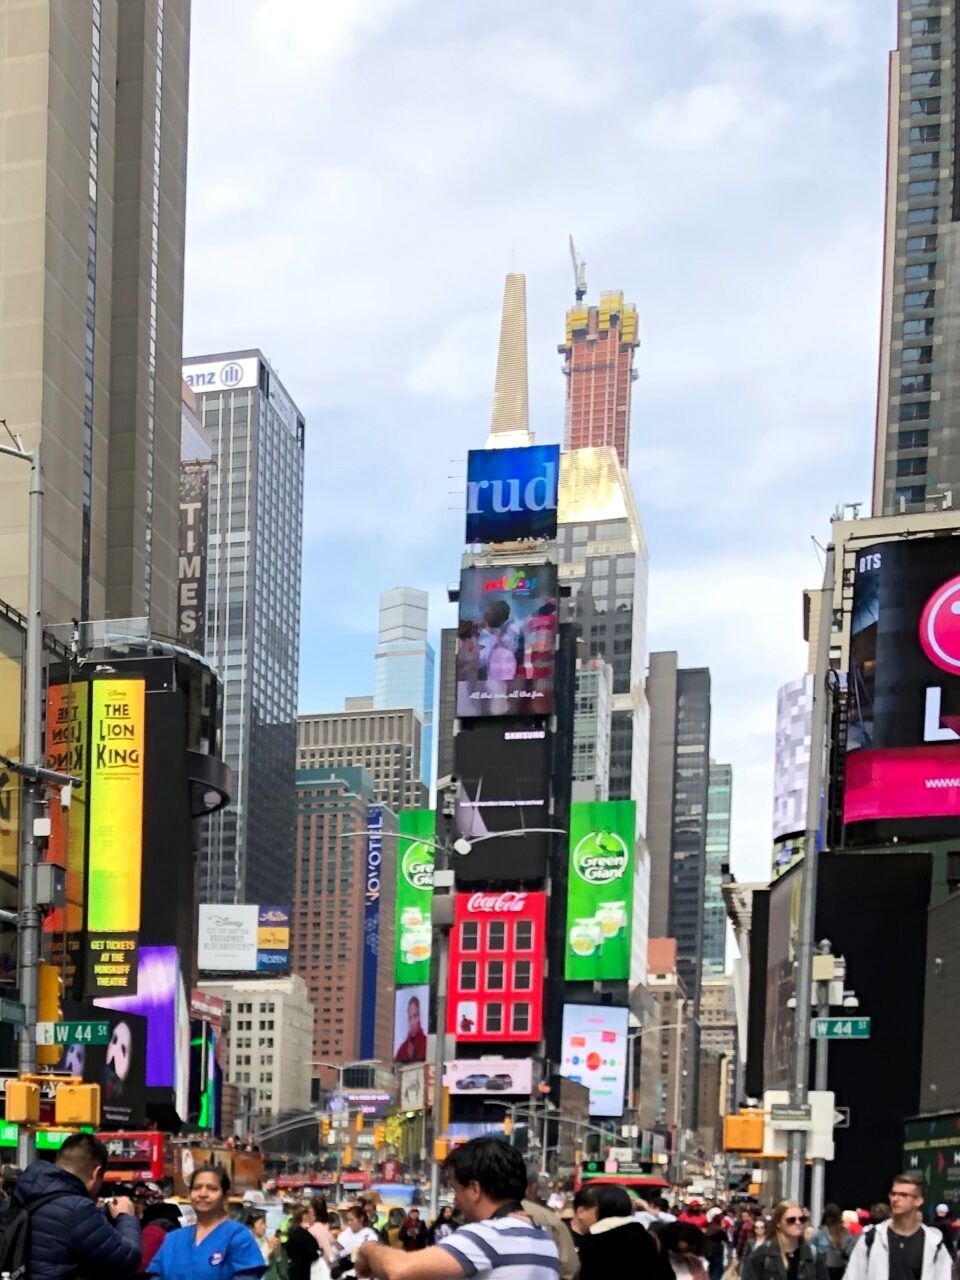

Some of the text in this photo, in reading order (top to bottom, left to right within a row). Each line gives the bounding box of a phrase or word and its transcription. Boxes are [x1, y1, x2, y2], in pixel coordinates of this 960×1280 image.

[178, 502, 202, 634] TIMES
[859, 553, 882, 574] BTS
[104, 703, 130, 717] THE
[99, 720, 135, 742] LION
[504, 730, 546, 741] SAMSUNG
[96, 743, 140, 769] KING
[365, 816, 383, 906] NOVOTEL
[581, 854, 624, 869] Green
[585, 865, 625, 882] Giant
[90, 940, 105, 950] GET
[106, 940, 136, 950] TICKETS
[100, 952, 125, 963] AT THE
[96, 977, 128, 987] THEATRE
[56, 1025, 69, 1042] W
[74, 1025, 92, 1042] 44
[817, 1024, 828, 1035] W
[833, 1023, 852, 1035] 44
